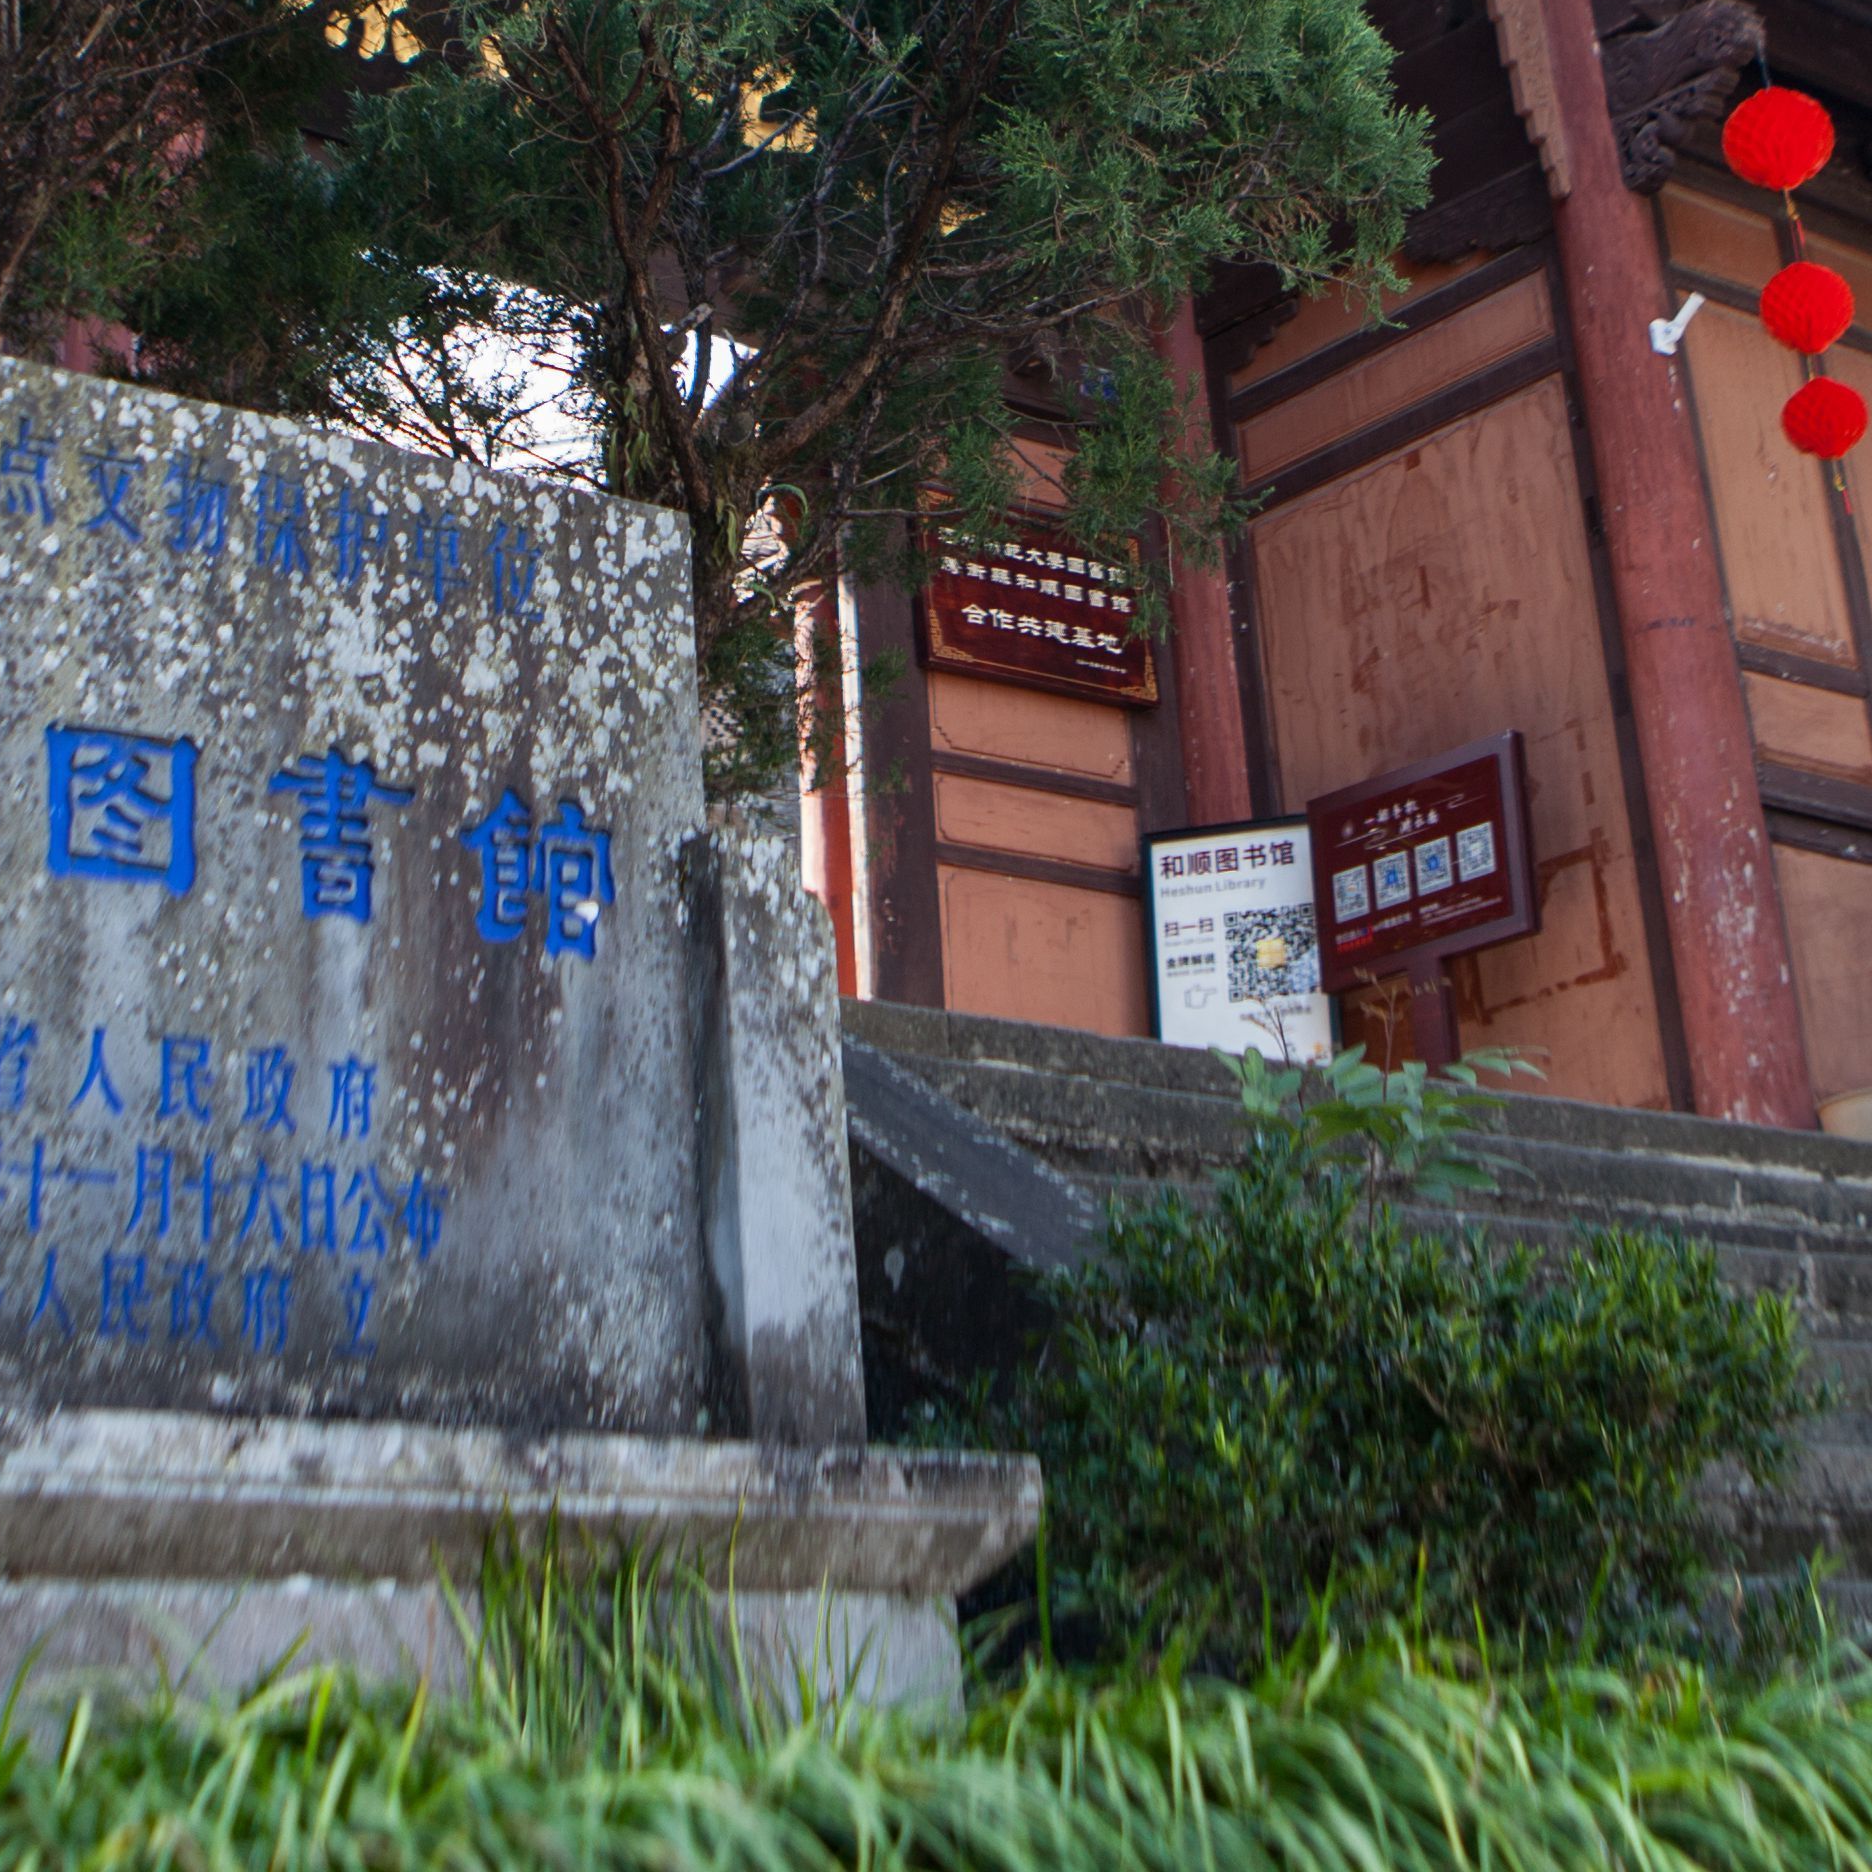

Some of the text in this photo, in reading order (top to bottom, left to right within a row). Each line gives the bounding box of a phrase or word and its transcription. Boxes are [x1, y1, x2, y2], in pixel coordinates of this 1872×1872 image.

[961, 603, 1123, 654] 合作共建基地
[1160, 840, 1296, 879] 和顺图书馆
[1161, 878, 1266, 898] Heshun Library
[1164, 918, 1214, 937] 扫一扫
